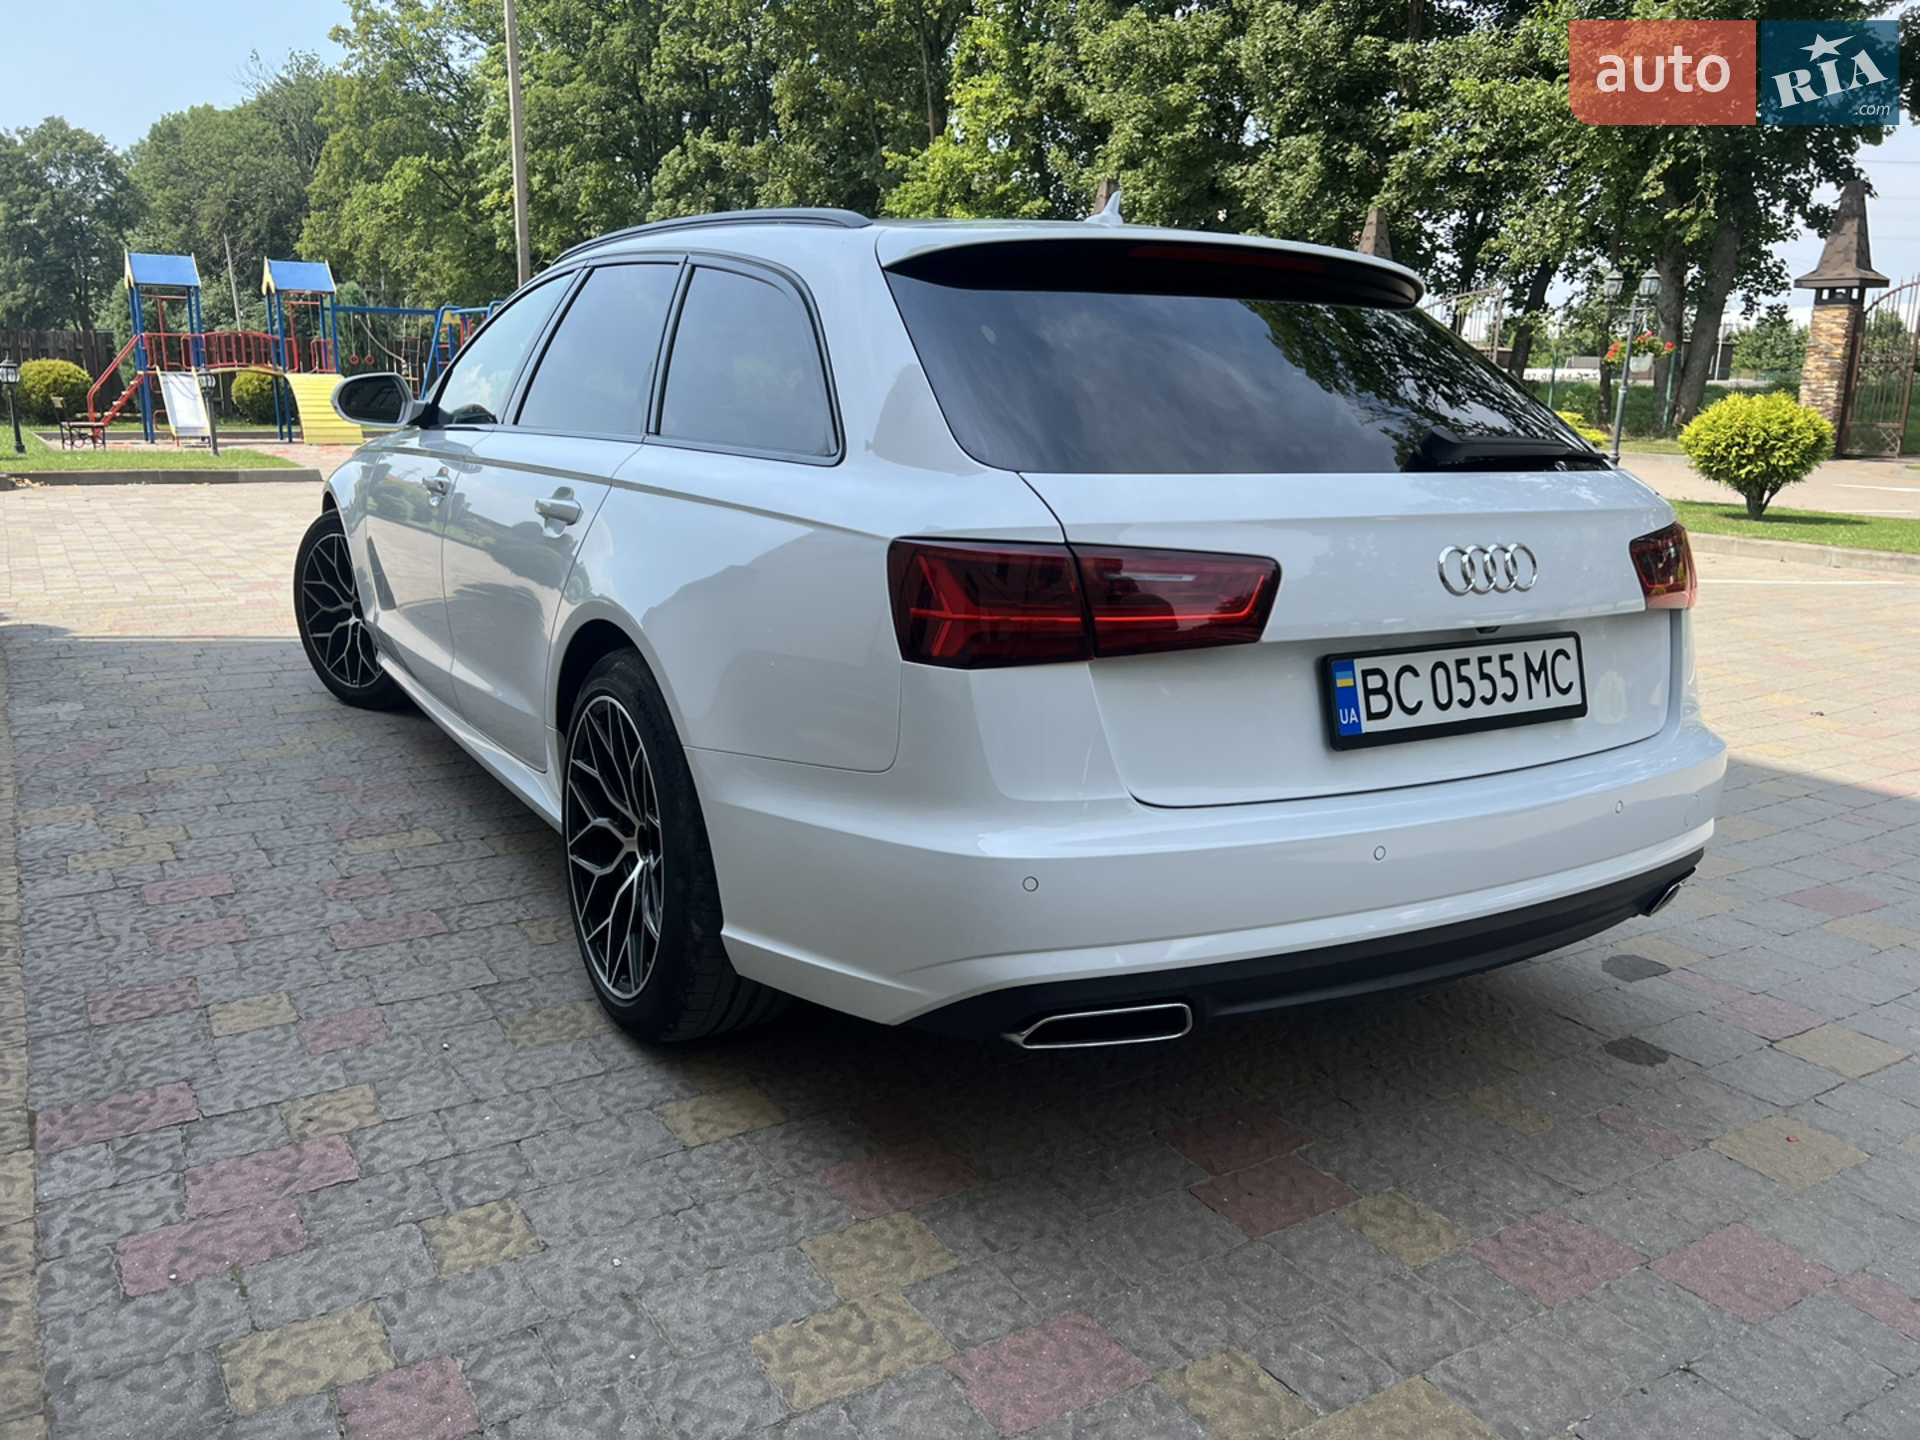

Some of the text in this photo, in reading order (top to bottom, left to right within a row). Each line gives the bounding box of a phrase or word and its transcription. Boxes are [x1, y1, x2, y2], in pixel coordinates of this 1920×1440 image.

[1361, 648, 1574, 721] BC 0555 MC
[1340, 708, 1359, 725] UA
